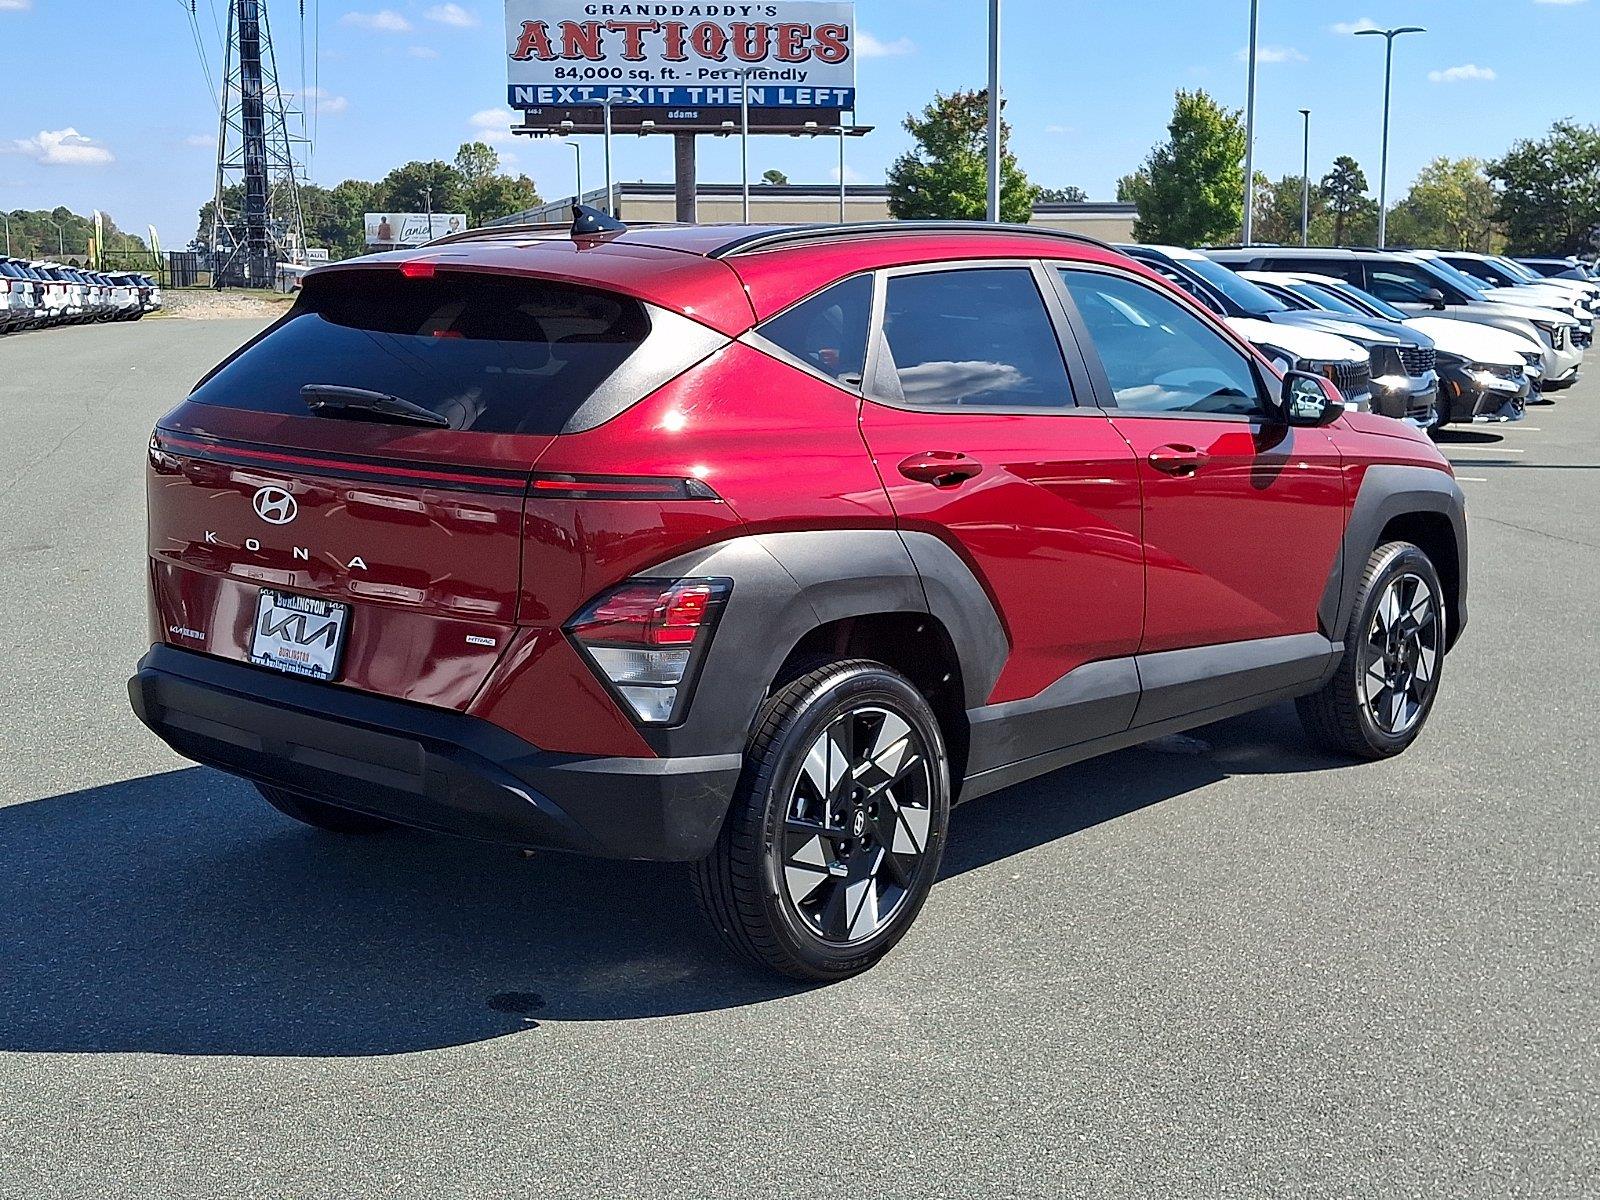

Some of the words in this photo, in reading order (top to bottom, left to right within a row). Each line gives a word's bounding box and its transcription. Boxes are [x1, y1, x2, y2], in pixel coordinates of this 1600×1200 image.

[584, 3, 777, 18] GRANDDADDY'S
[509, 19, 849, 64] ANTIQUES
[554, 66, 623, 82] 84,000
[628, 69, 655, 82] sq.
[660, 67, 680, 80] ft.
[698, 68, 728, 80] Pet
[514, 86, 594, 104] NEXT
[607, 87, 675, 104] EXIT
[687, 87, 765, 104] THEN
[778, 88, 848, 106] LEFT
[667, 110, 699, 120] adams
[399, 218, 430, 242] Lanie
[204, 530, 368, 571] KONA
[276, 593, 326, 615] BURLINGTON
[261, 608, 338, 650] KIA
